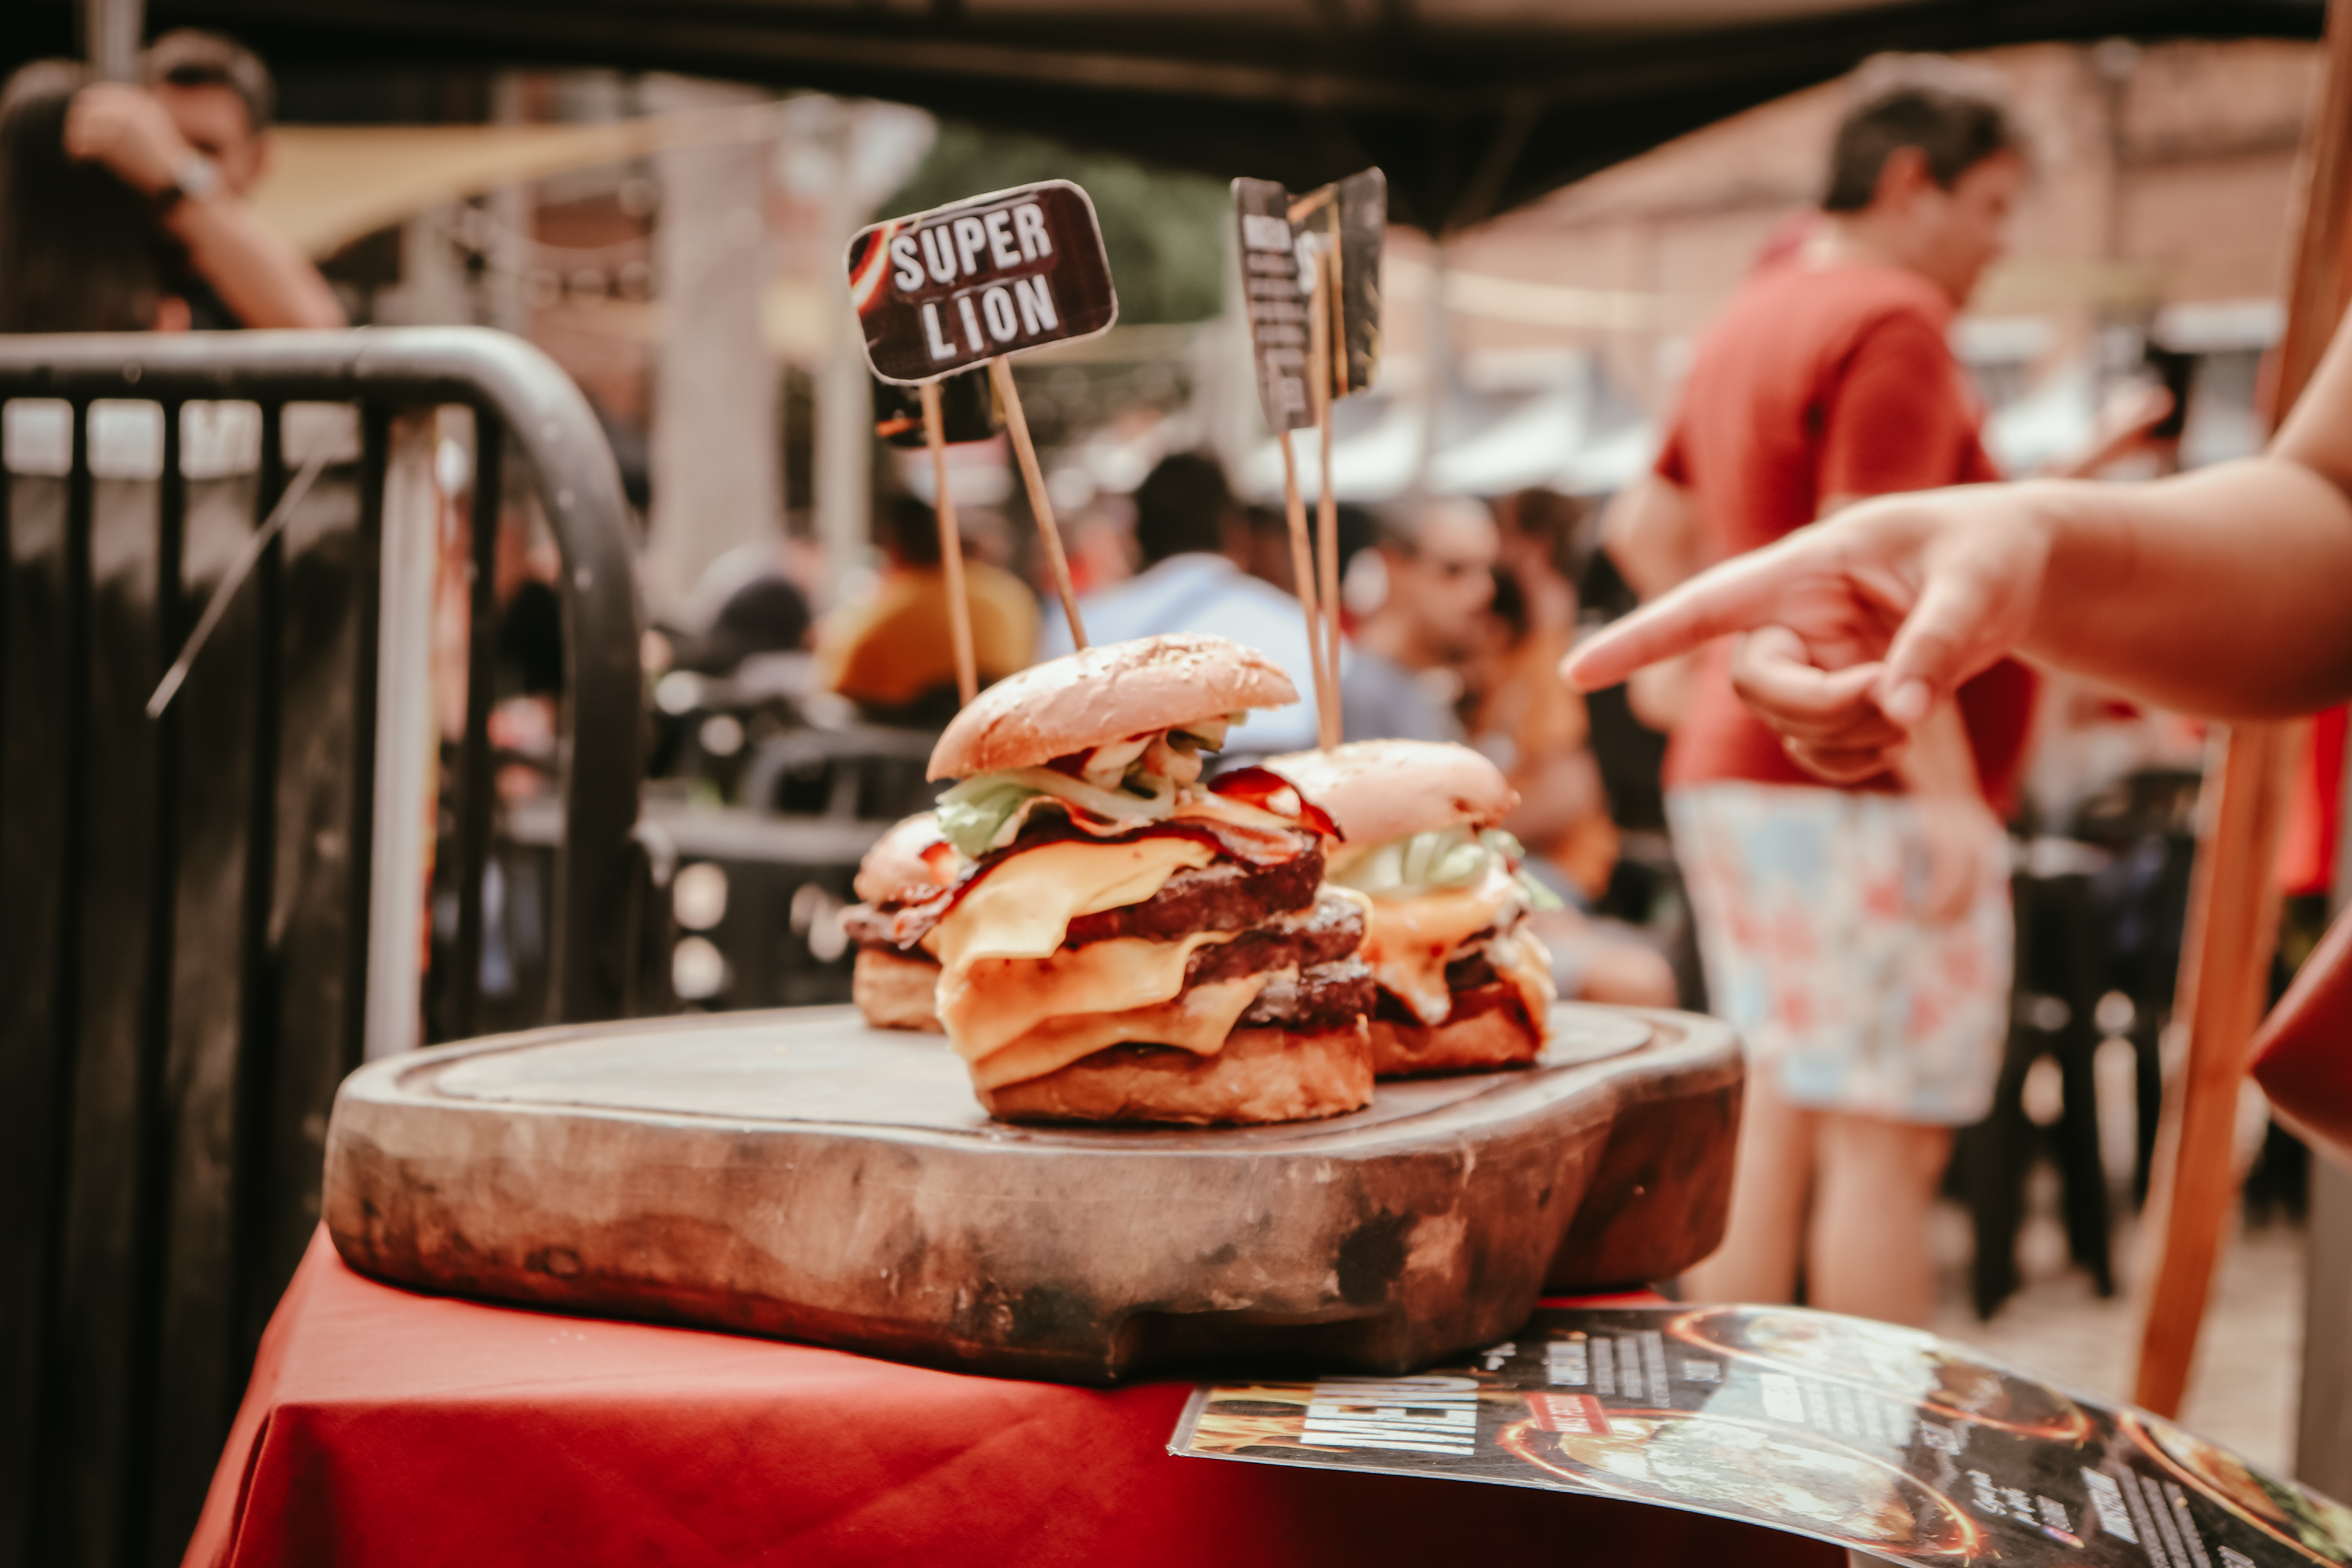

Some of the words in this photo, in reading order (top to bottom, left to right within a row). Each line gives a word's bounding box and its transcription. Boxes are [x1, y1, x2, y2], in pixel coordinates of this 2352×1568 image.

[890, 202, 1053, 292] SUPER
[922, 274, 1058, 361] LION
[1300, 1376, 1479, 1455] MENU
